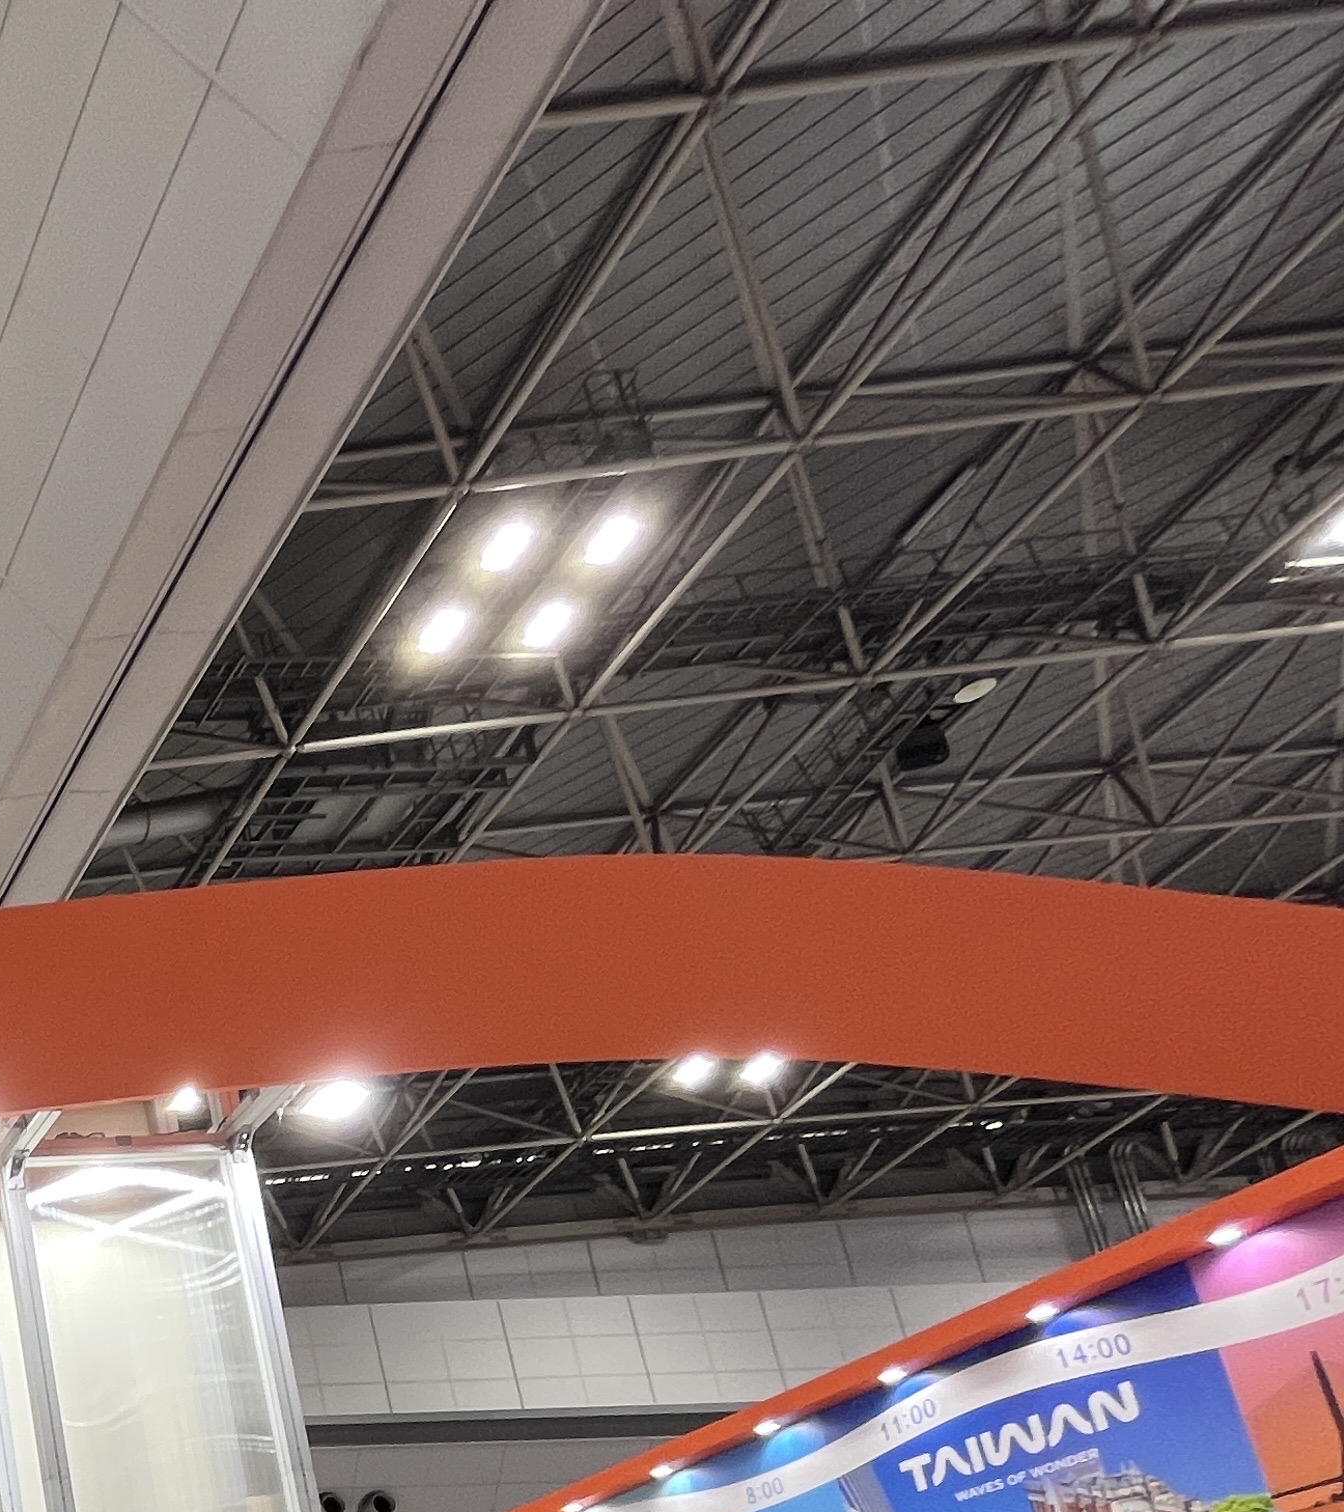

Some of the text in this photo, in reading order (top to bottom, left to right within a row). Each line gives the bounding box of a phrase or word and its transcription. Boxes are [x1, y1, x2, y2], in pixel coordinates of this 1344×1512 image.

[1056, 1333, 1132, 1369] 14:00
[878, 1398, 937, 1442] 11:00
[898, 1380, 1140, 1493] TAIWAN
[745, 1476, 785, 1505] 8:00
[954, 1448, 1100, 1502] WAVES OF WONDER
